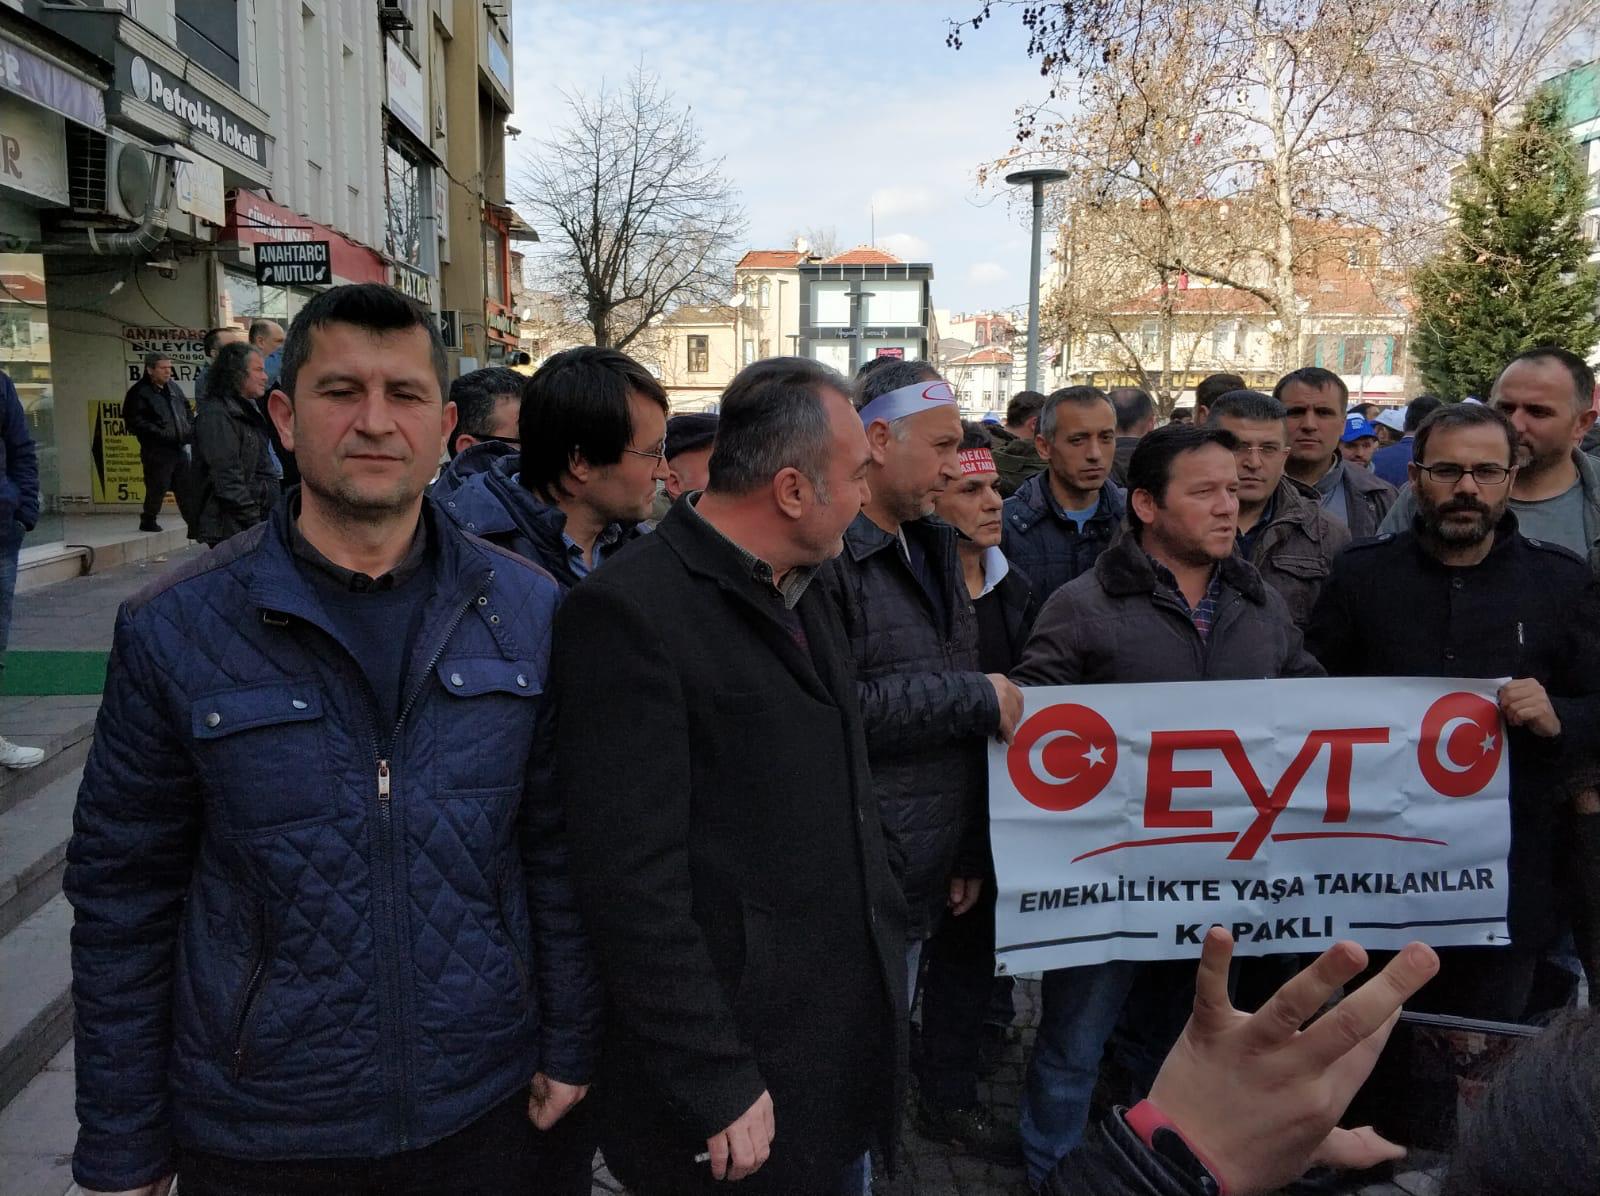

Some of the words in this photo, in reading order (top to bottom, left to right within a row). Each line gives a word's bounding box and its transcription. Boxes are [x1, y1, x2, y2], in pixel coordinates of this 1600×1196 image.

[222, 119, 259, 161] lokali
[259, 244, 327, 263] ANAHTARCI
[273, 265, 315, 282] MUTLU
[126, 328, 207, 341] ANAHTARC
[132, 340, 205, 352] BİLEYİC
[1142, 726, 1390, 861] EYT
[1019, 874, 1221, 914] EMEKLİLİKTE
[1232, 875, 1306, 905] YAŞA
[1313, 867, 1495, 897] TAKILANLAR
[1175, 915, 1333, 946] KPAKLI
